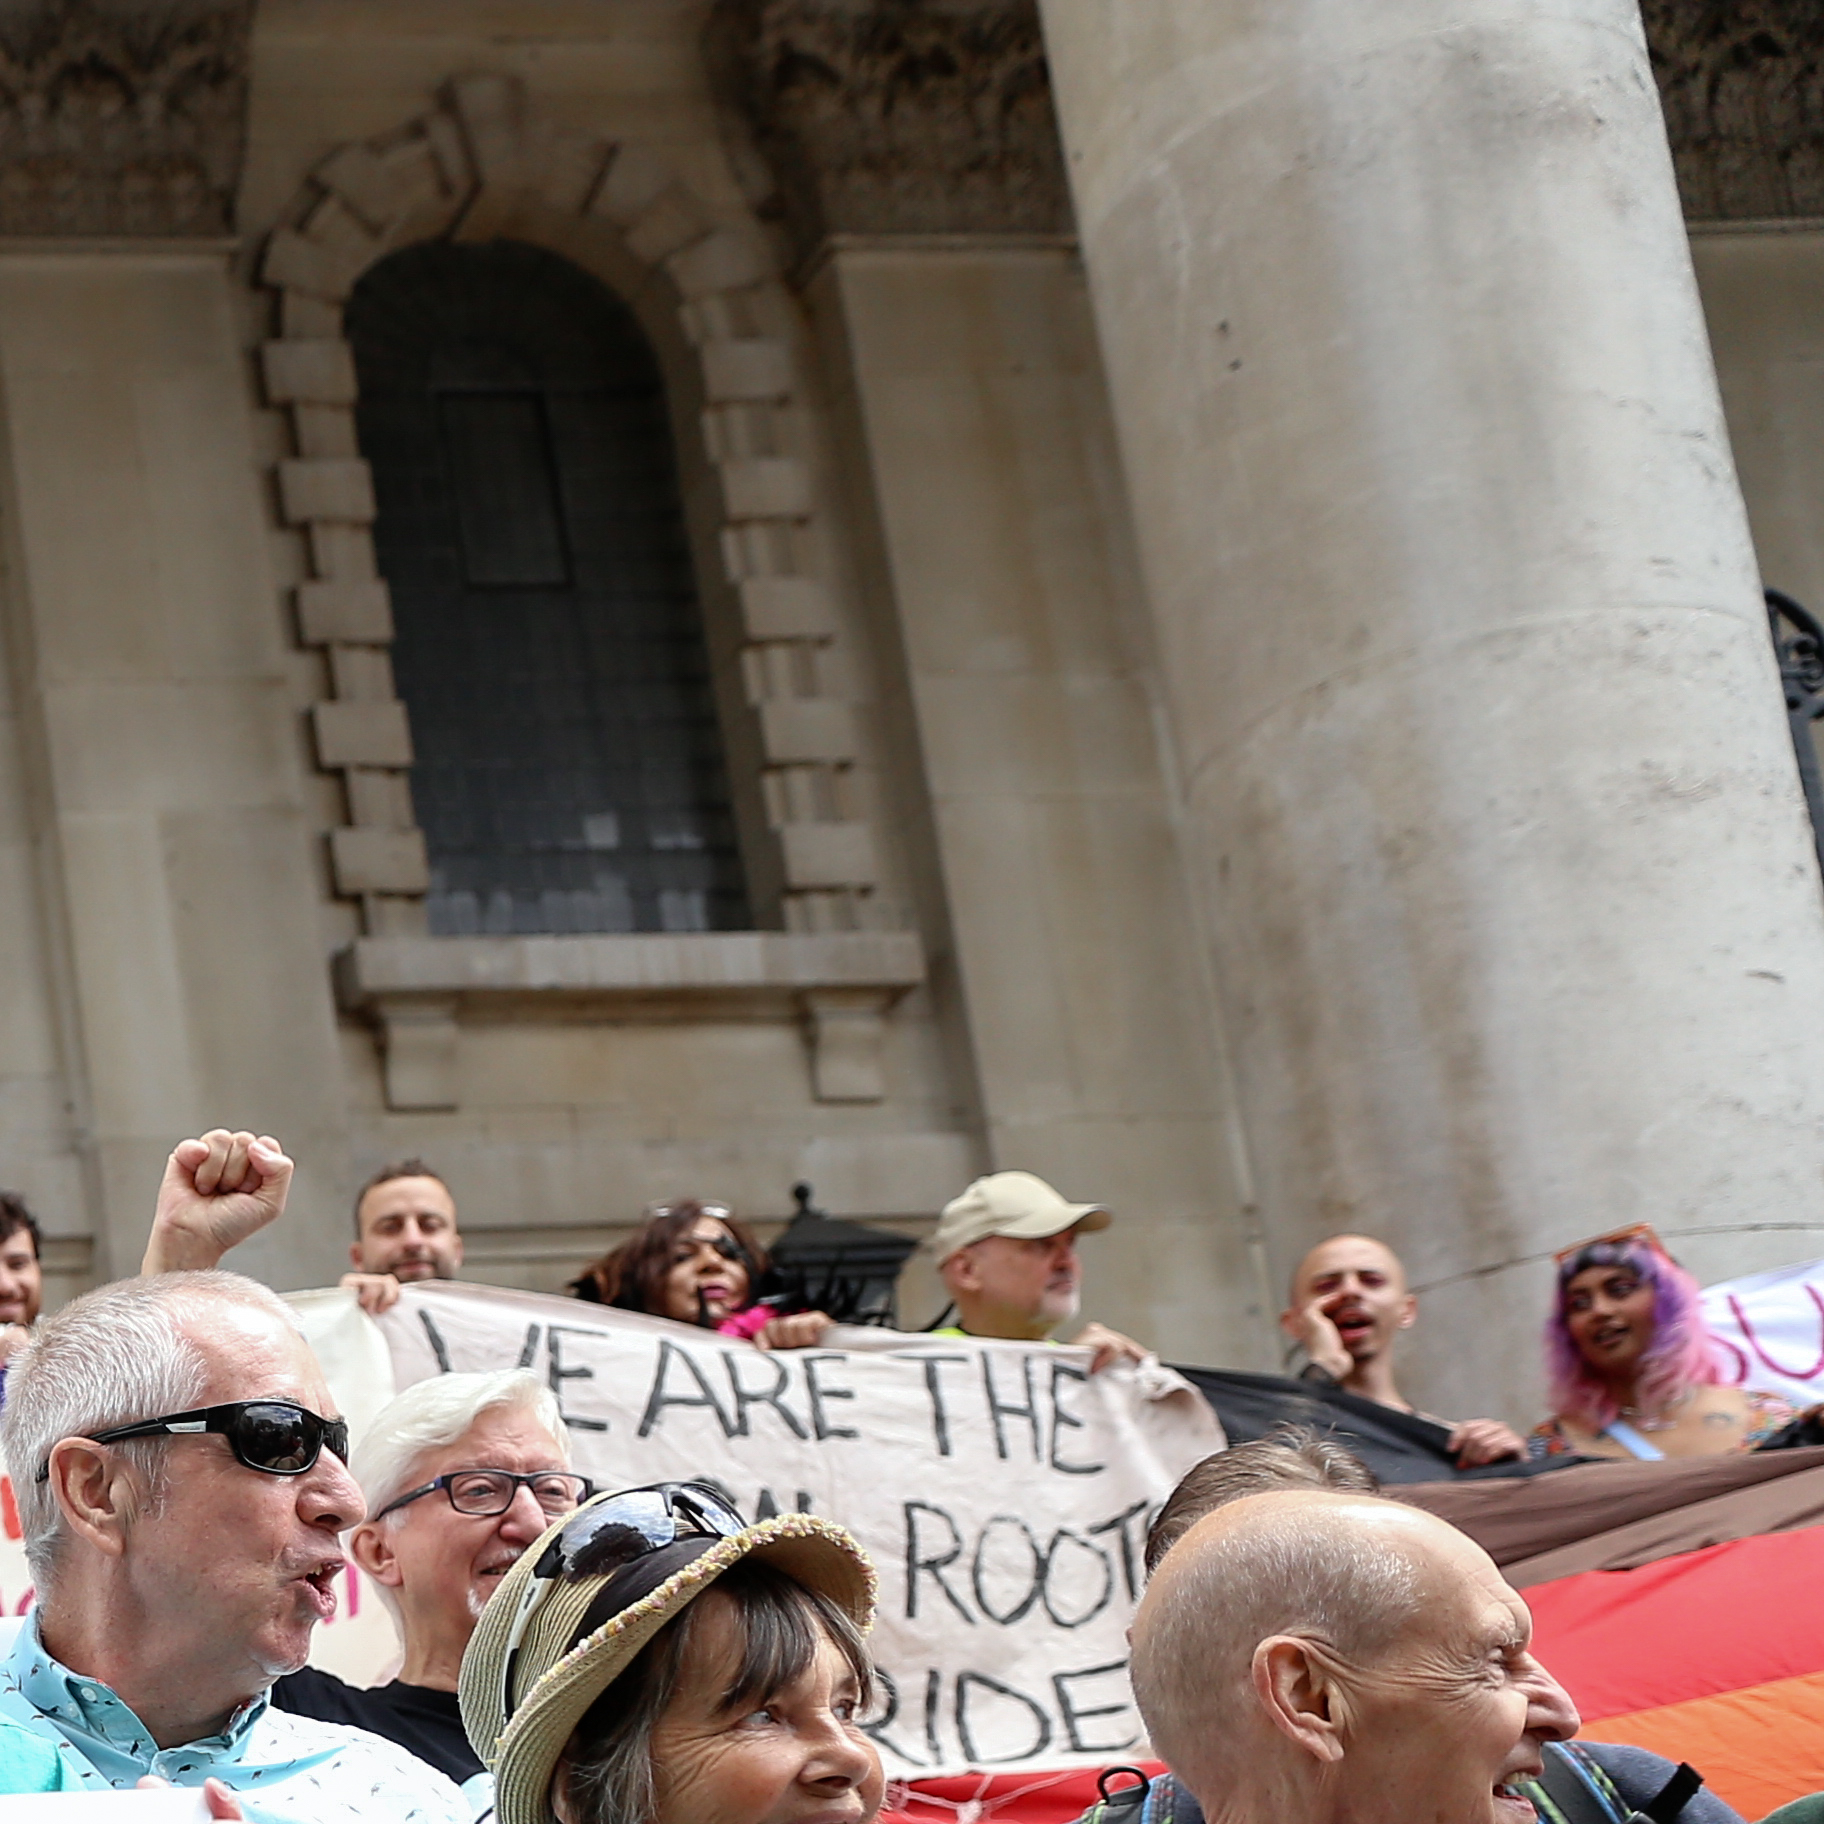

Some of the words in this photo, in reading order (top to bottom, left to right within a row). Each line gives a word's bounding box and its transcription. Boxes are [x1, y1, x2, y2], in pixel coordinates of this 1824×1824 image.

[639, 1339, 859, 1441] ARE
[893, 1350, 1106, 1475] THE
[905, 1499, 1162, 1628] ROOT
[854, 1658, 1140, 1766] RIDE
